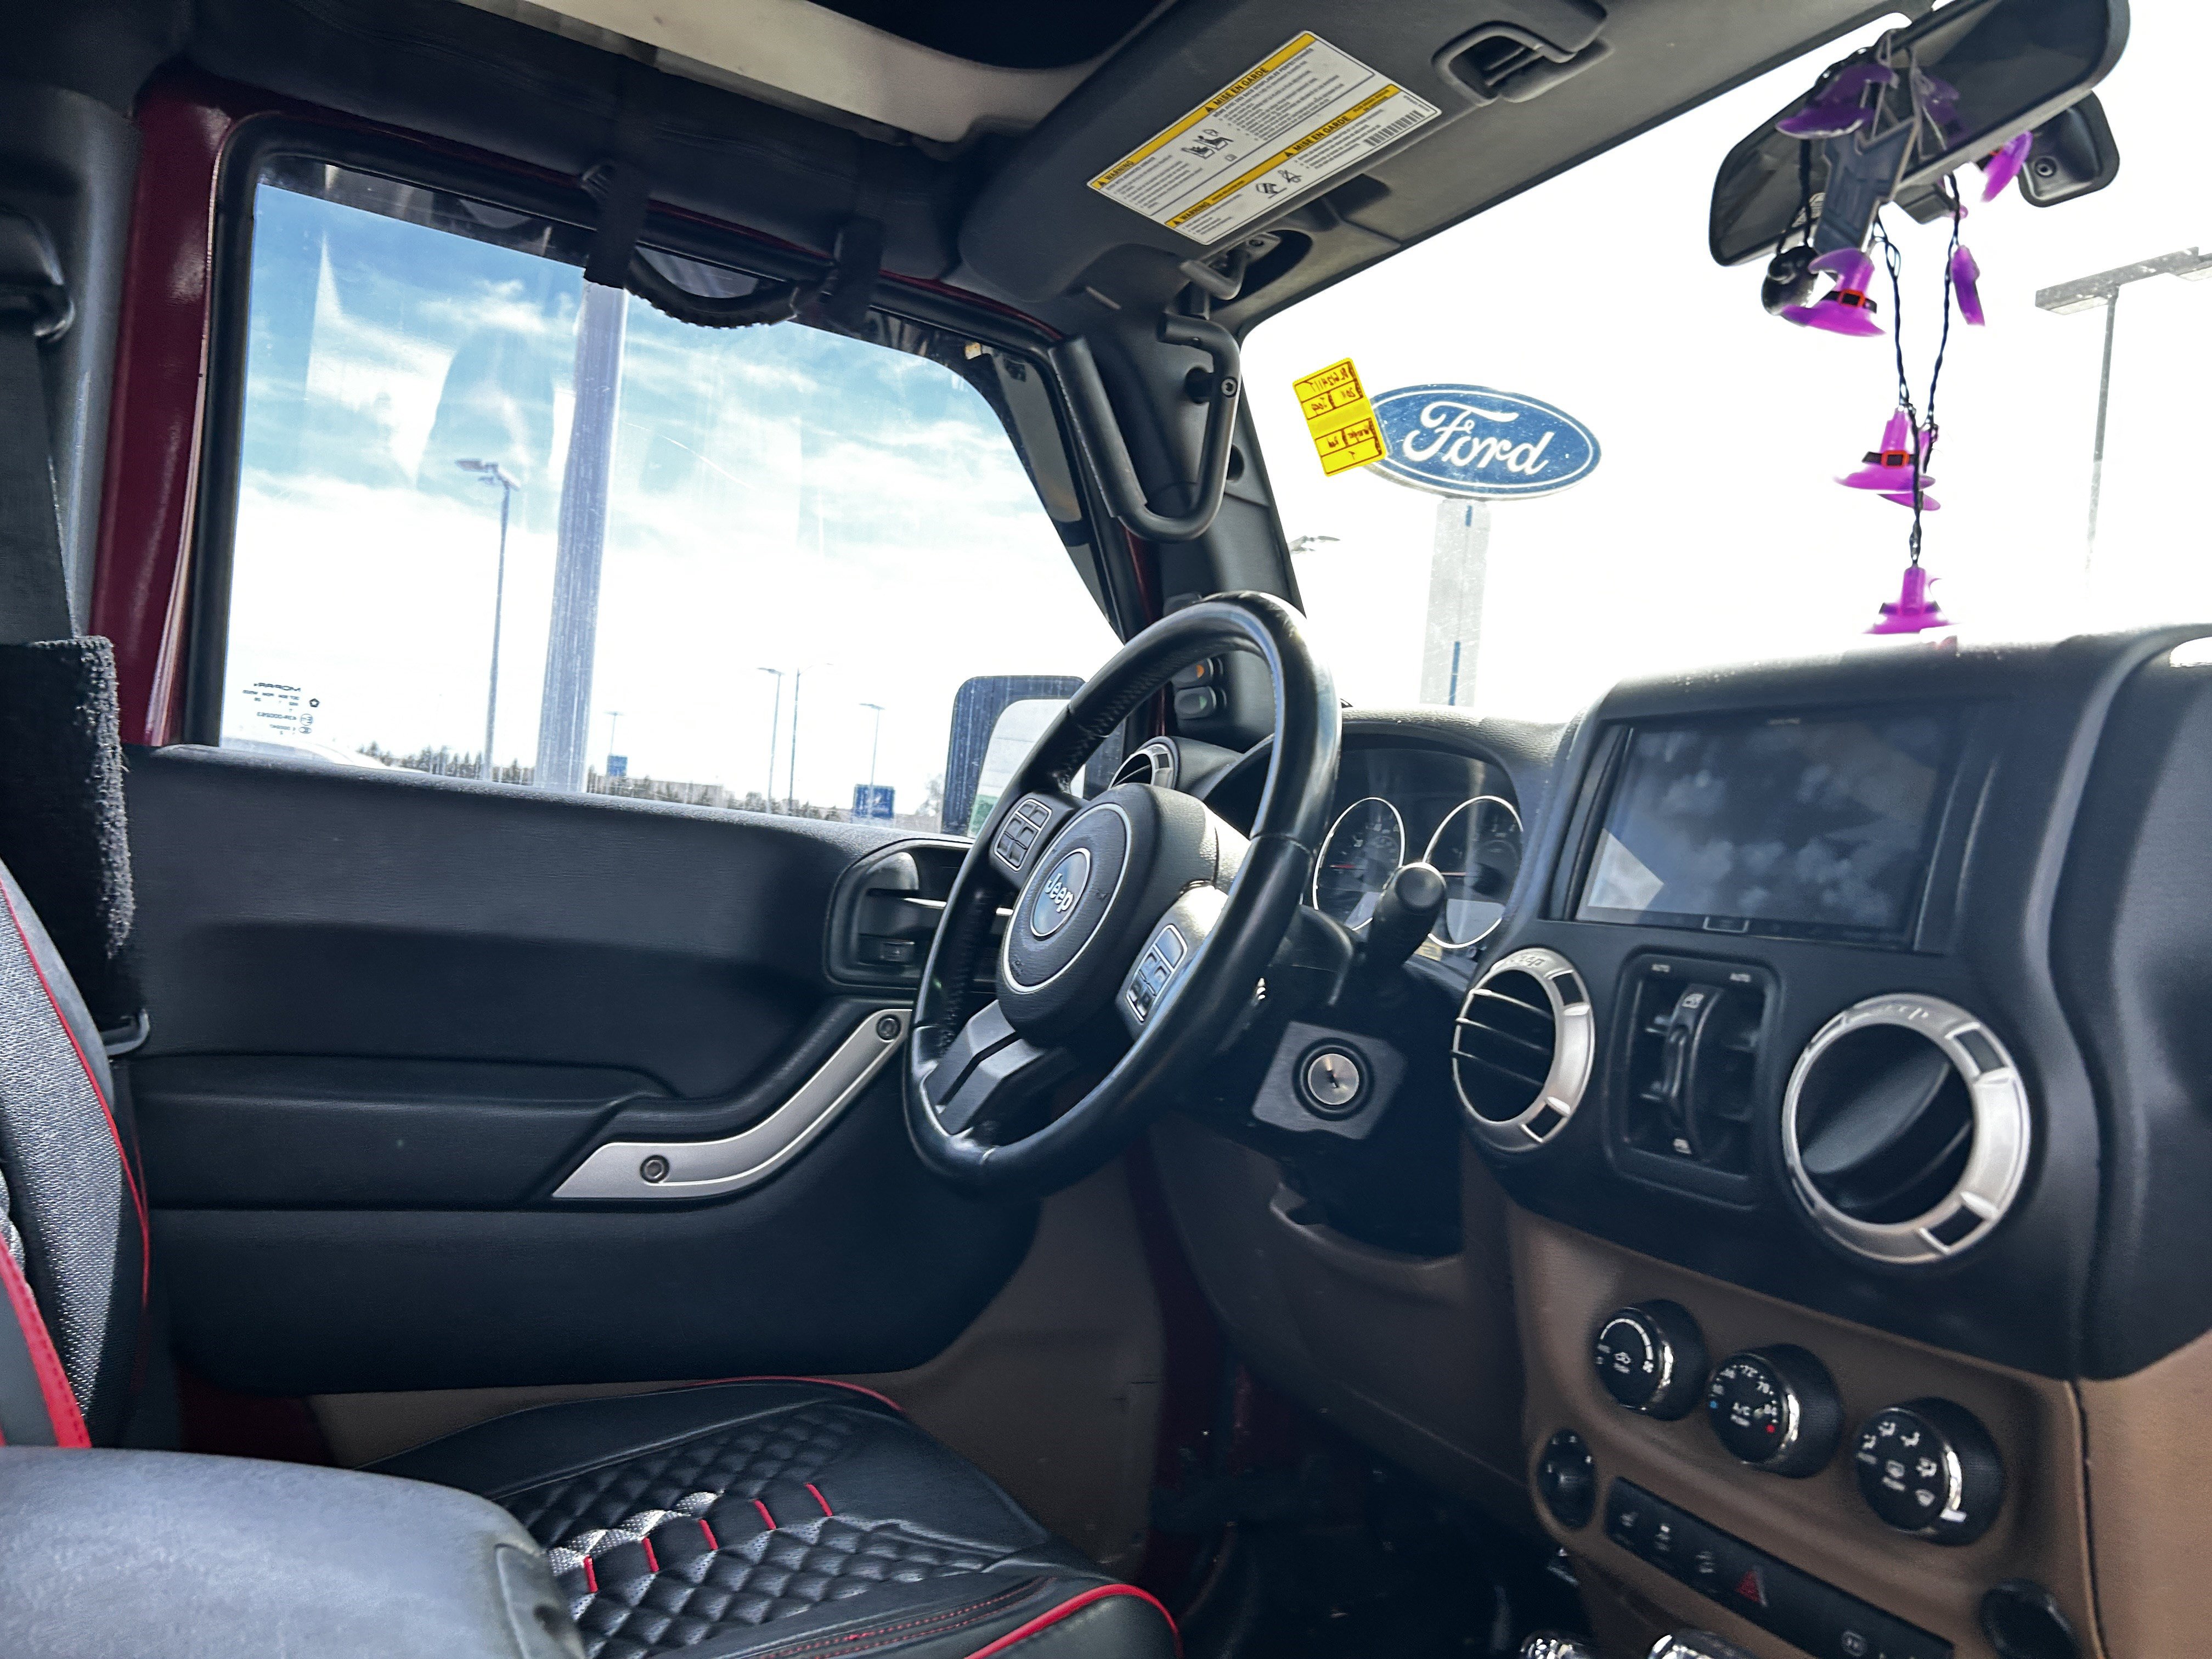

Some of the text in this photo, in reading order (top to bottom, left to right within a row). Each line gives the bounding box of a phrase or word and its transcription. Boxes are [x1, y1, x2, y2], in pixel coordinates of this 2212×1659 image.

[1213, 92, 1234, 106] MISE
[1231, 85, 1244, 94] EN
[1242, 67, 1269, 87] GARDE
[1293, 138, 1313, 151] MISE
[1323, 115, 1351, 134] GARDE
[1104, 160, 1135, 180] WARNING
[1181, 201, 1211, 220] WARNING
[1402, 401, 1555, 476] Ford
[1045, 873, 1074, 913] Jeep
